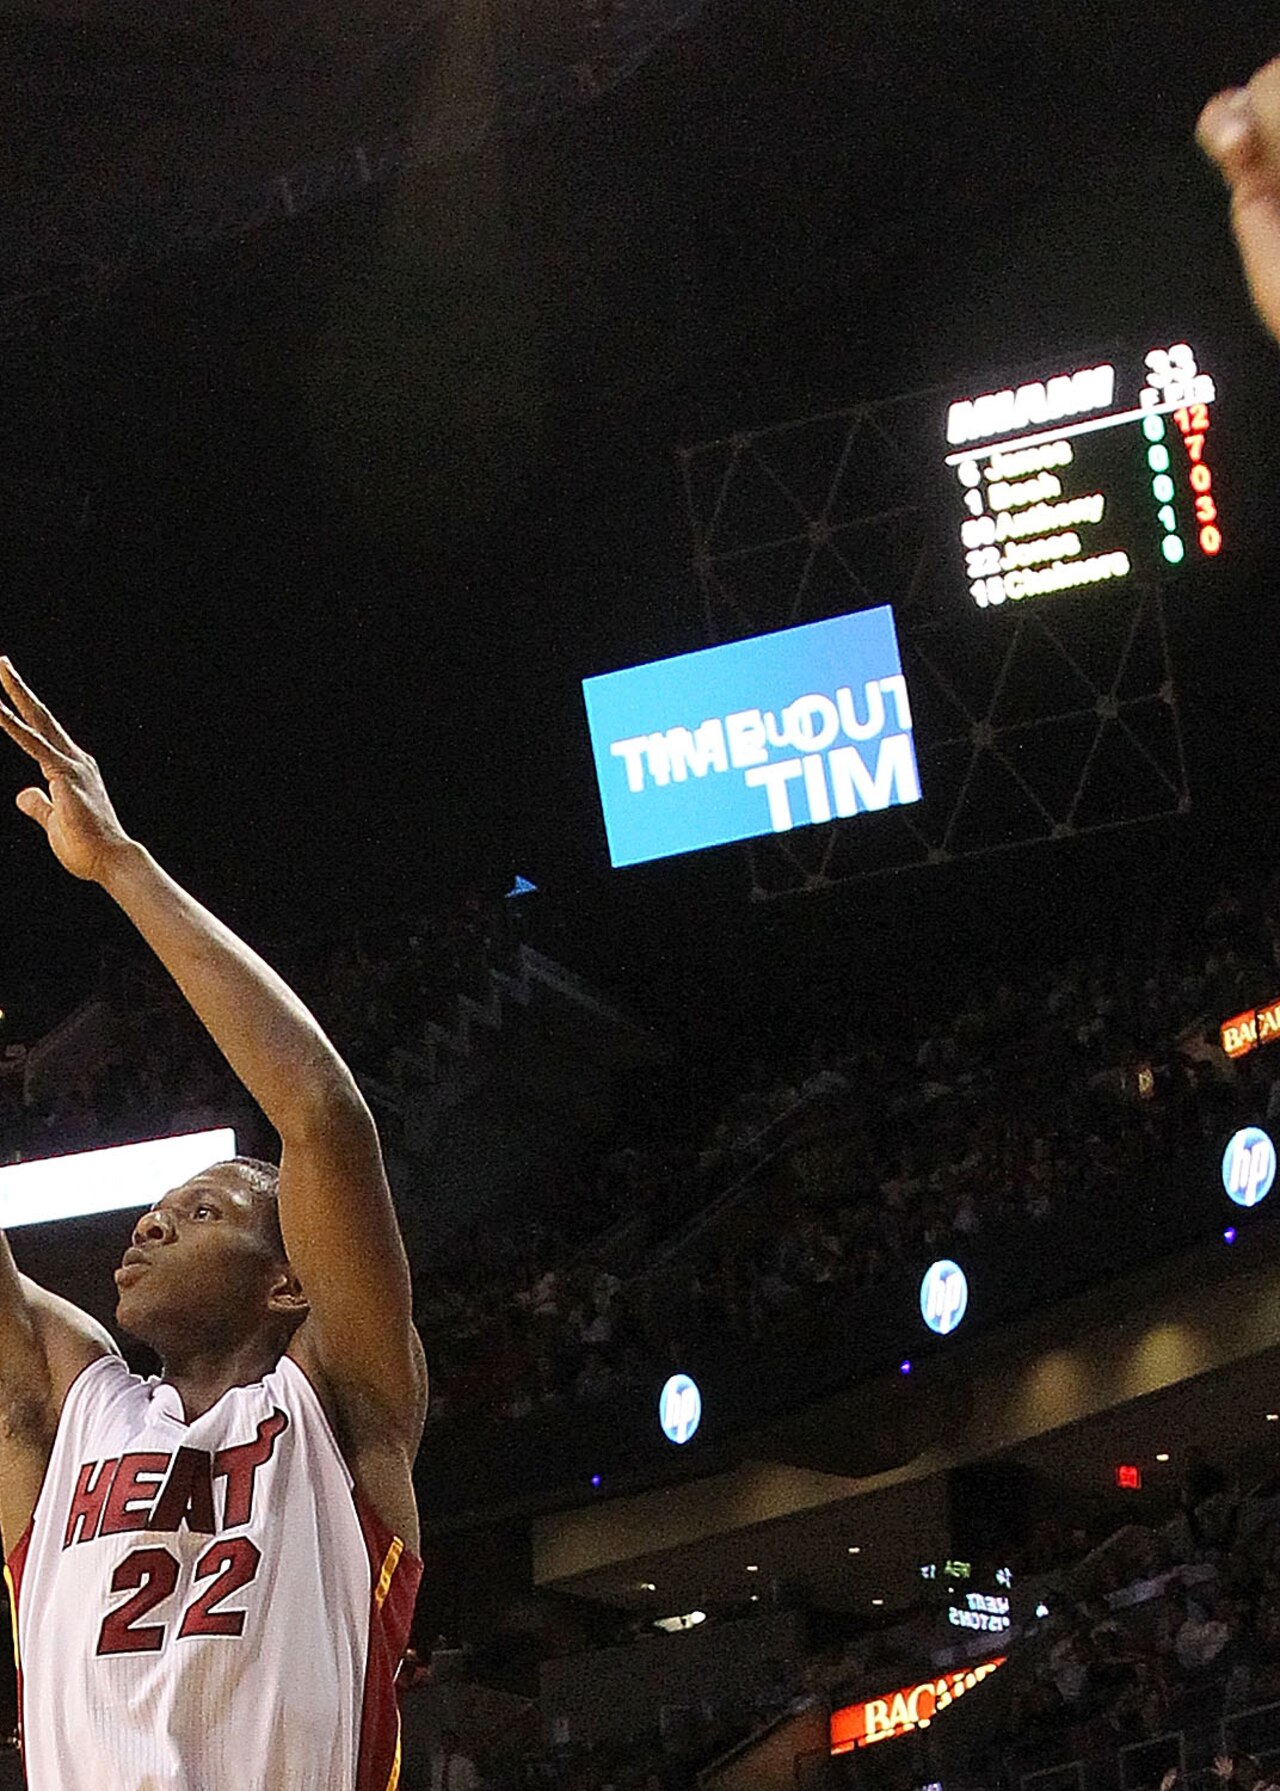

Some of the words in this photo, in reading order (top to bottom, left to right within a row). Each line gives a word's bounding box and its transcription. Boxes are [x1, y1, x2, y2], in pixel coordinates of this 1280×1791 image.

[1173, 402, 1209, 433] 12
[1183, 434, 1204, 462] 7
[1190, 463, 1212, 492] 0
[1157, 505, 1176, 531] 1
[1195, 496, 1217, 522] 3
[1199, 525, 1221, 556] 0
[744, 733, 921, 833] TIM
[1226, 1130, 1270, 1206] hp
[63, 1406, 289, 1552] HEAT
[96, 1536, 262, 1656] 22
